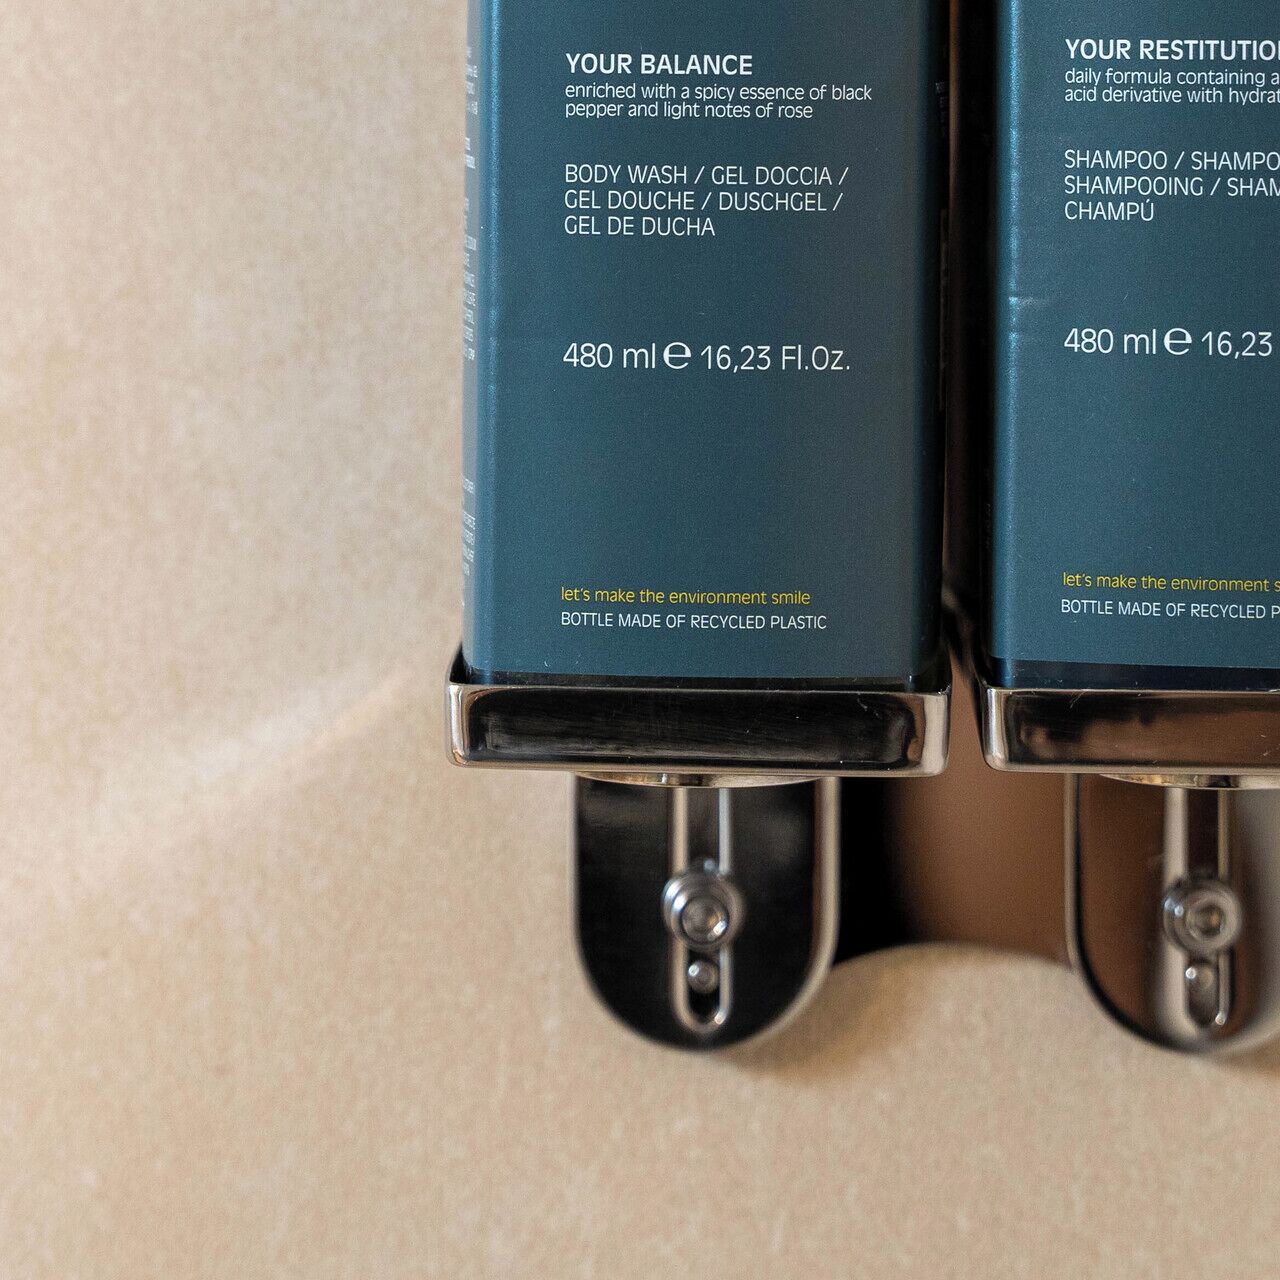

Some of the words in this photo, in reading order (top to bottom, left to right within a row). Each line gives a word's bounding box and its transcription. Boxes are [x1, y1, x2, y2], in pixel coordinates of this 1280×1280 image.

[1066, 39, 1131, 59] YOUR
[566, 53, 632, 74] YOUR
[641, 54, 752, 75] BALANCE
[1065, 68, 1102, 88] daily
[1106, 68, 1171, 84] formula
[1175, 69, 1266, 88] containing
[565, 83, 636, 98] enriched
[641, 83, 675, 99] with
[681, 87, 689, 99] a
[695, 87, 735, 101] spicy
[740, 87, 804, 100] essence
[809, 84, 827, 100] of
[832, 85, 872, 100] black
[1065, 86, 1099, 102] acid
[1102, 87, 1182, 102] derivative
[1187, 87, 1222, 103] with
[566, 103, 624, 118] pepper
[628, 101, 658, 117] and
[664, 101, 700, 119] light
[705, 103, 751, 118] notes
[755, 102, 773, 118] of
[778, 106, 813, 118] rose
[1065, 149, 1167, 169] SHAMPOO
[1174, 151, 1185, 169] /
[566, 164, 621, 183] BODY
[628, 165, 687, 184] WASH
[694, 166, 705, 184] /
[712, 166, 748, 184] GEL
[756, 166, 832, 185] DOCCIA
[839, 167, 849, 185] /
[1065, 175, 1203, 196] SHAMPOOING
[1210, 178, 1221, 195] /
[565, 190, 601, 208] GEL
[608, 191, 694, 210] DOUCHE
[701, 192, 712, 210] /
[719, 192, 827, 211] DUSCHGEL
[833, 193, 843, 211] /
[1065, 199, 1154, 221] CHAMPÚ
[565, 215, 600, 234] GEL
[608, 216, 634, 235] DE
[642, 217, 715, 236] DUCHA
[1064, 328, 1113, 353] 480
[1124, 329, 1156, 354] ml
[1202, 331, 1272, 359] 16,23
[563, 343, 613, 368] 480
[623, 343, 655, 368] ml
[701, 345, 770, 373] 16,23
[1063, 572, 1092, 587] let's
[1097, 575, 1137, 588] make
[1141, 575, 1166, 589] the
[1171, 577, 1269, 591] environment
[562, 587, 590, 601] let's
[595, 589, 635, 602] make
[640, 589, 665, 603] the
[669, 590, 767, 604] environment
[772, 591, 810, 604] smile
[1062, 599, 1113, 614] BOTTLE
[1118, 602, 1160, 616] MADE
[1166, 603, 1185, 617] OF
[1191, 604, 1266, 618] RECYCLED
[561, 612, 613, 626] BOTTLE
[619, 614, 661, 628] MADE
[666, 614, 685, 628] OF
[691, 615, 765, 629] RECYCLED
[771, 615, 826, 629] PLASTIC
